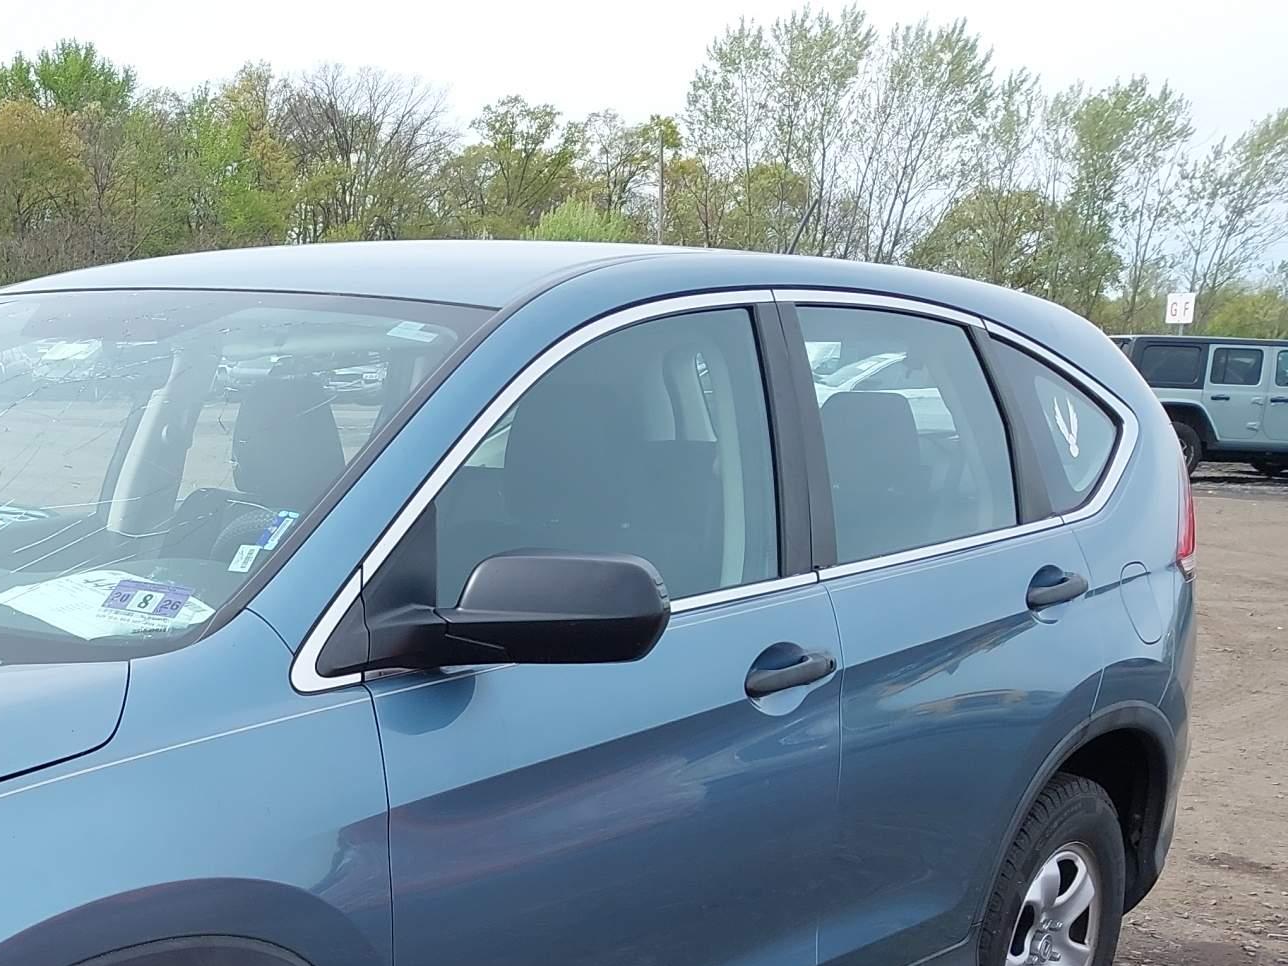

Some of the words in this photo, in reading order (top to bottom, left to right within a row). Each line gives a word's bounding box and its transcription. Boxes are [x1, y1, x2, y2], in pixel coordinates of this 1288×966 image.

[1170, 302, 1178, 317] G
[1183, 301, 1190, 316] F
[111, 591, 131, 603] 20
[137, 593, 154, 609] 8
[159, 599, 182, 611] 26
